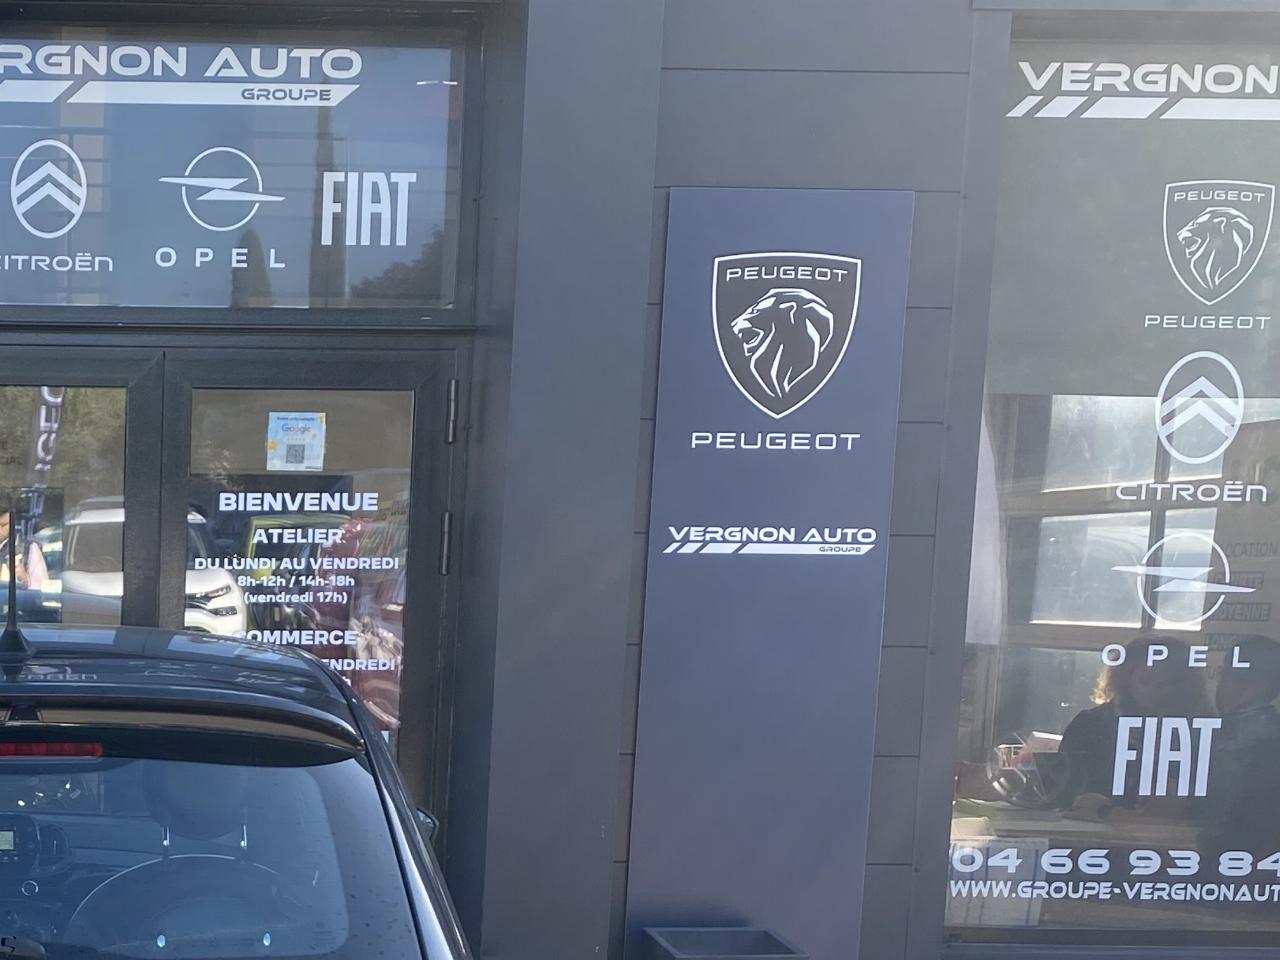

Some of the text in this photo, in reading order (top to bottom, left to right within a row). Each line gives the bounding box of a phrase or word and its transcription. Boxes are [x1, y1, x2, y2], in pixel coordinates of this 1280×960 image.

[203, 47, 363, 79] AUTO
[1018, 62, 1278, 93] VERGNON
[241, 87, 332, 102] GROUPE
[1174, 190, 1265, 203] PEUGEOT
[321, 171, 417, 246] FIAT
[155, 247, 285, 268] OPEL
[726, 266, 848, 281] PEUGEOT
[1144, 315, 1271, 329] PEUGEOT
[691, 433, 860, 450] PEUGEOT
[219, 493, 379, 511] BIENVENUE
[252, 529, 342, 543] ATELIER
[669, 526, 877, 543] VERGNON AUTO
[194, 558, 399, 569] DU LUNDI AU VENDREDI
[237, 576, 286, 586] 8h-12h
[299, 575, 355, 587] 14h-18h
[244, 592, 348, 604] (vendredi 17h)
[1101, 644, 1251, 667] OPEL
[320, 659, 395, 670] ENDREDI
[1111, 717, 1222, 797] FIAT
[952, 848, 1280, 877] 04 66 93 84
